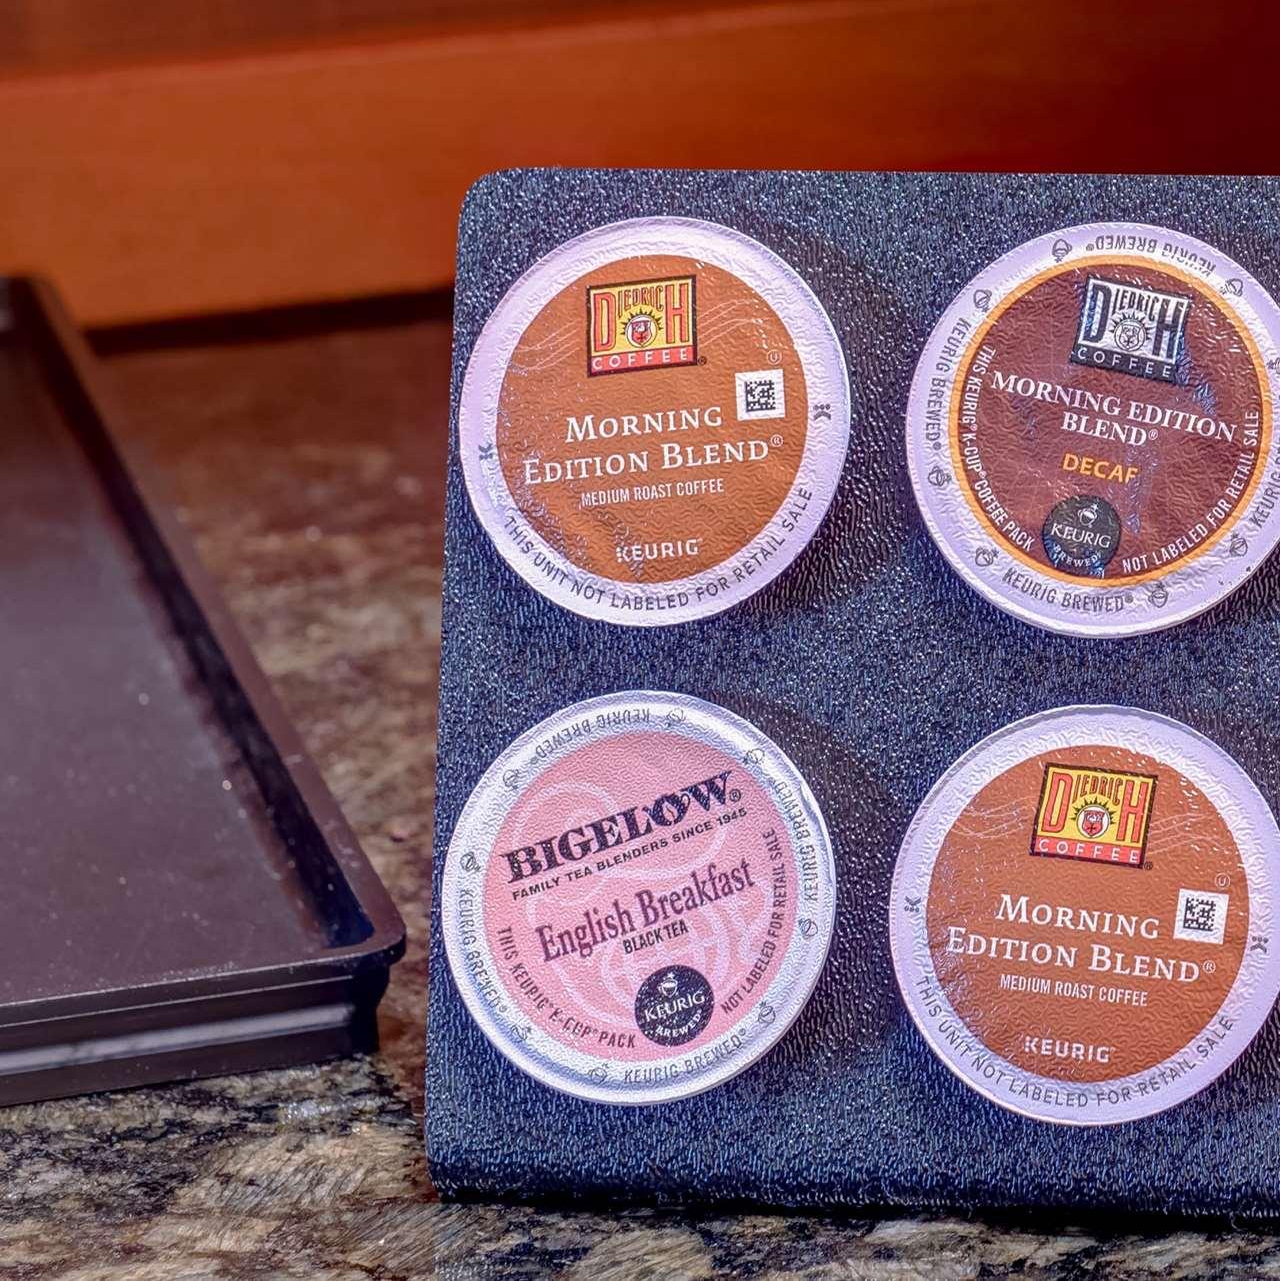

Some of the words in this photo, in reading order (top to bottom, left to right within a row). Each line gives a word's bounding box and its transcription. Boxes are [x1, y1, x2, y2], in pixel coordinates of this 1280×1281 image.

[593, 283, 690, 353] DIEDRICH
[1083, 284, 1184, 357] DIEDRICH
[592, 348, 688, 370] COFFEE
[935, 318, 972, 373] KEURIG
[973, 345, 997, 376] THIS
[1077, 347, 1171, 377] COFFEE
[565, 406, 722, 443] MORNING
[990, 371, 1121, 416] MORNING
[1126, 400, 1237, 443] EDITION
[523, 451, 648, 485] EDITION
[1062, 453, 1139, 484] DECAF
[581, 487, 630, 507] MEDIUM
[634, 483, 672, 501] ROAST
[676, 478, 724, 496] COFFEE
[974, 480, 1010, 523] COFFEE
[1122, 553, 1148, 574] NOT
[1154, 524, 1209, 564] LABELED
[1206, 499, 1232, 528] FOR
[1225, 453, 1255, 499] RETAIL
[1243, 410, 1260, 447] SALE
[504, 516, 533, 554] THIS
[534, 550, 566, 585] UNIT
[571, 581, 605, 605] NOT
[609, 591, 689, 611] LABELED
[696, 577, 730, 602] FOR
[735, 535, 785, 582] RETAIL
[782, 487, 813, 532] SALE
[616, 539, 698, 563] KEURIG
[1003, 519, 1036, 552] PACK
[1051, 523, 1111, 548] KEURIG
[1002, 568, 1058, 603] KEURIG
[1041, 772, 1150, 843] DIEDRICH
[512, 876, 560, 901] FAMILY
[565, 867, 593, 882] TEA
[597, 840, 668, 871] BLENDERS
[672, 822, 713, 843] SINCE
[718, 807, 747, 825] 1945
[763, 828, 783, 861] SALE
[1038, 839, 1140, 864] COFFEE
[772, 862, 787, 909] RETAIL
[534, 899, 637, 963] English
[635, 857, 755, 928] Breakfast
[768, 911, 783, 938] FOR
[995, 894, 1160, 940] MORNING
[623, 931, 664, 955] BLACK
[666, 919, 689, 938] TEA
[947, 926, 1078, 968] EDITION
[742, 940, 776, 992] LABELED
[498, 925, 519, 961] THIS
[599, 1031, 636, 1048] PACK
[721, 990, 743, 1014] NOT
[1000, 974, 1051, 994] MEDIUM
[1055, 981, 1094, 1000] ROAST
[1099, 987, 1148, 1007] COFFEE
[644, 990, 705, 1022] KEURIG
[916, 975, 943, 1017] THIS
[938, 1020, 972, 1057] UNIT
[971, 1056, 1007, 1085] NOT
[1008, 1078, 1088, 1107] LABELED
[1096, 1087, 1132, 1107] FOR
[1137, 1060, 1196, 1096] RETAIL
[1196, 1016, 1234, 1058] SALE
[1023, 1036, 1111, 1063] KEURIG
[624, 1064, 678, 1084] KEURIG
